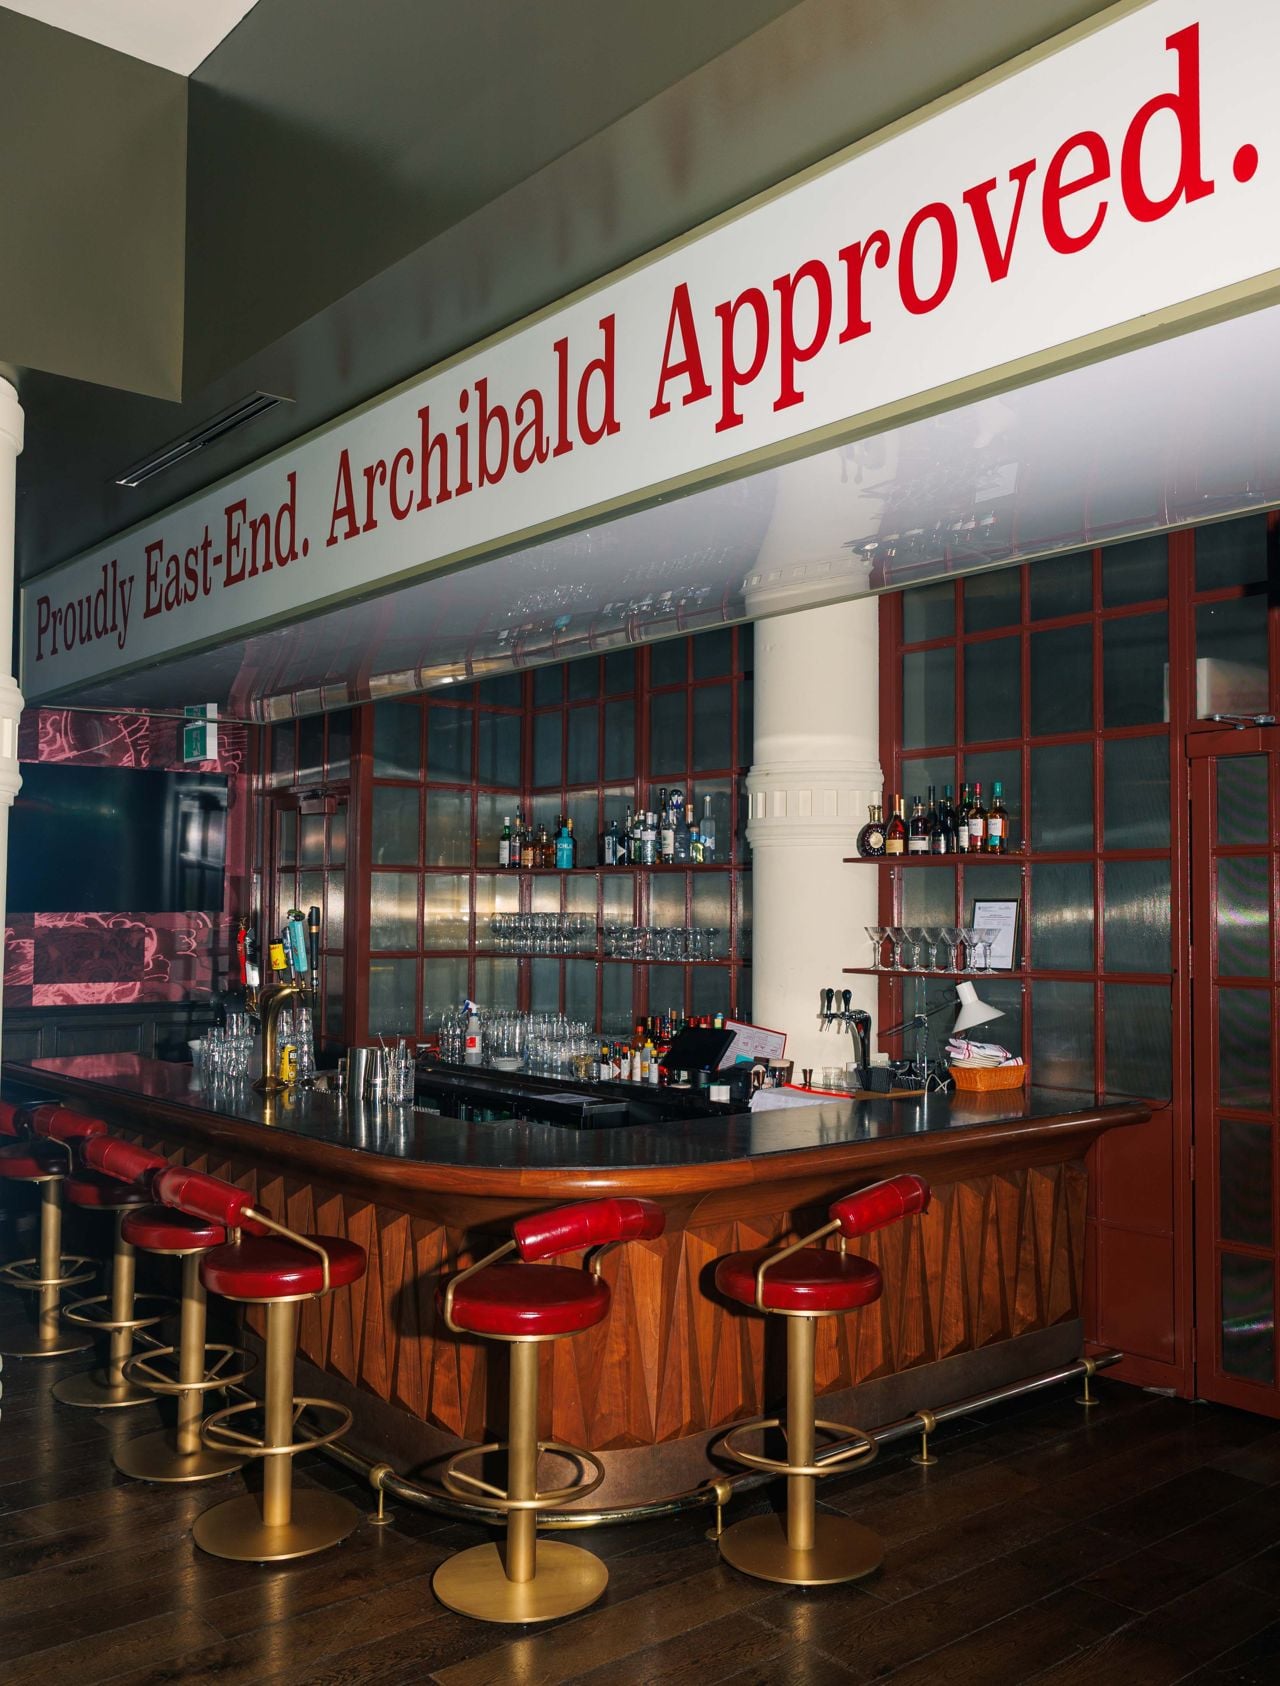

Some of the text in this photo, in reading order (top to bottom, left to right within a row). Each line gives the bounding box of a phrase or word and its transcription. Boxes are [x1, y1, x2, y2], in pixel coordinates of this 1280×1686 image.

[36, 22, 1260, 649] Proudly East-End. Archibald Approved.
